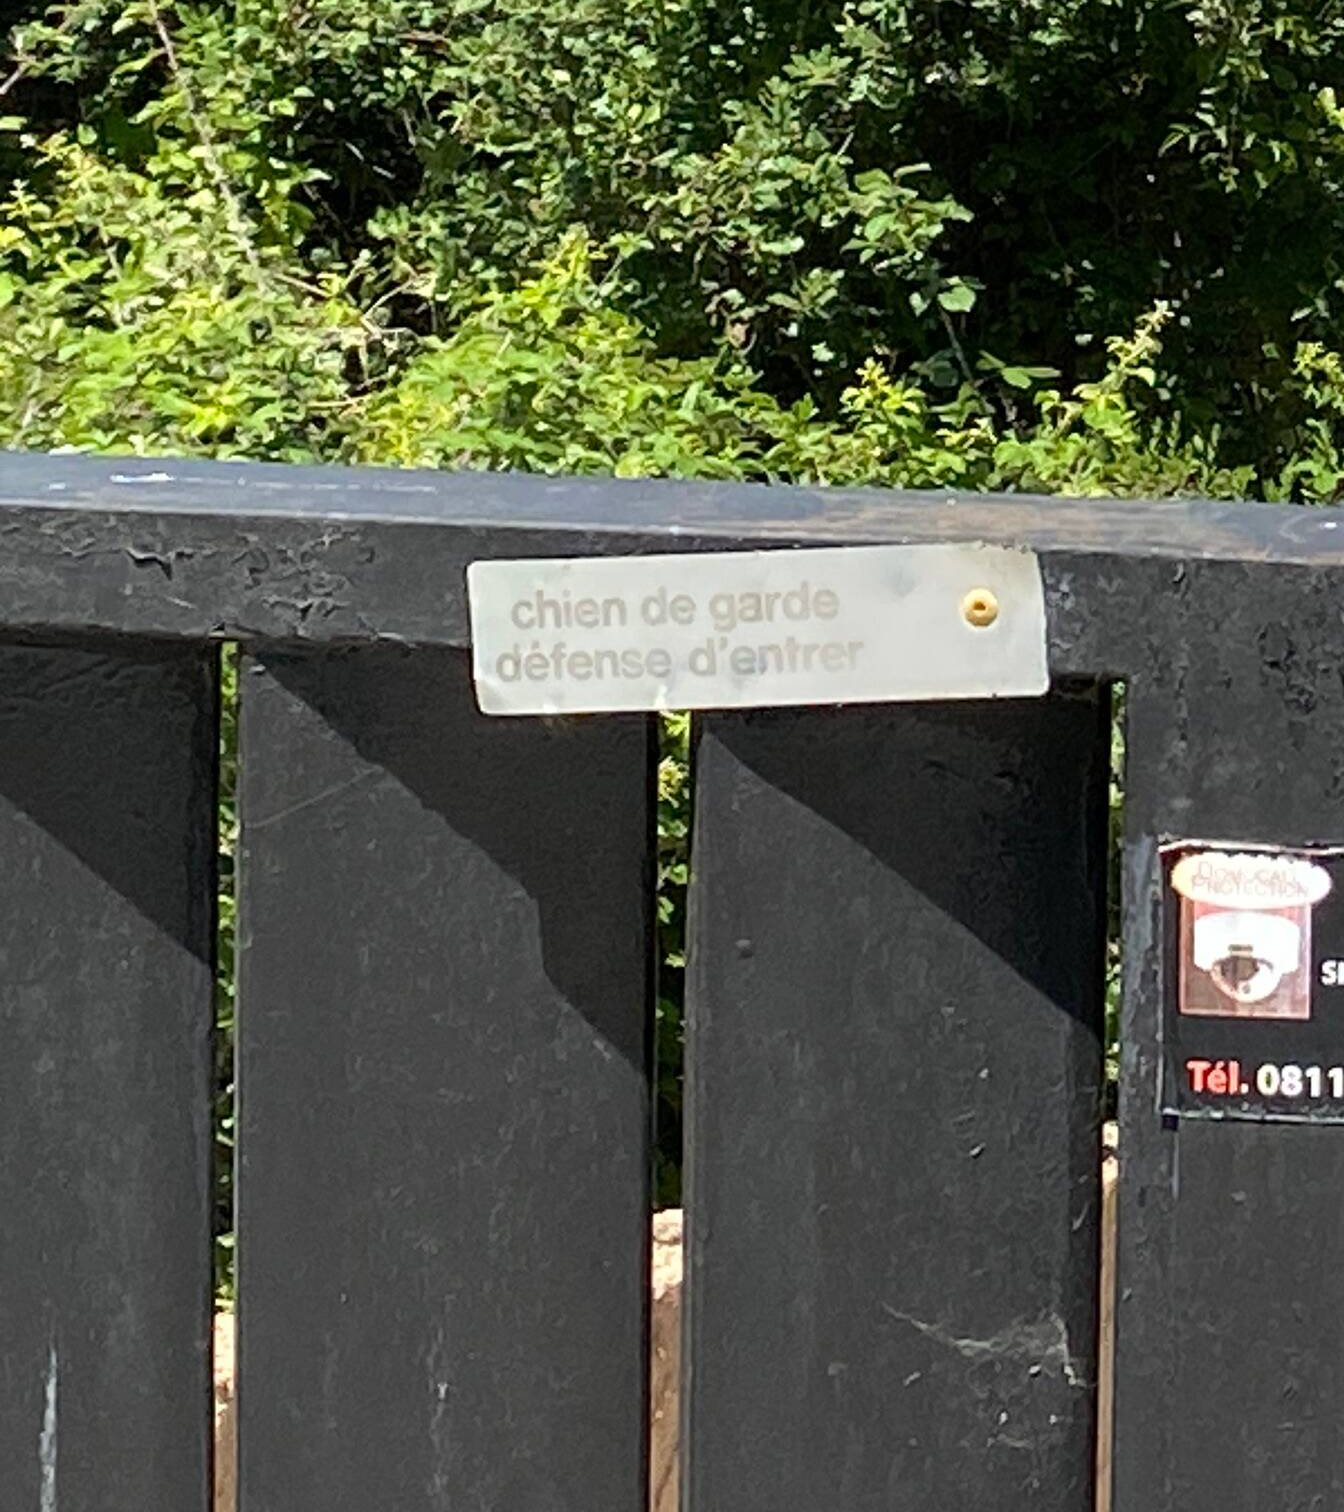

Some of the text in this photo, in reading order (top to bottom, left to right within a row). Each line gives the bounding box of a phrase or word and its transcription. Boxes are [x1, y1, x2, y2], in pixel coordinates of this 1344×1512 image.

[511, 581, 840, 630] chien de garde
[495, 634, 865, 683] défense d'entrer
[1186, 1059, 1249, 1095] Tél.
